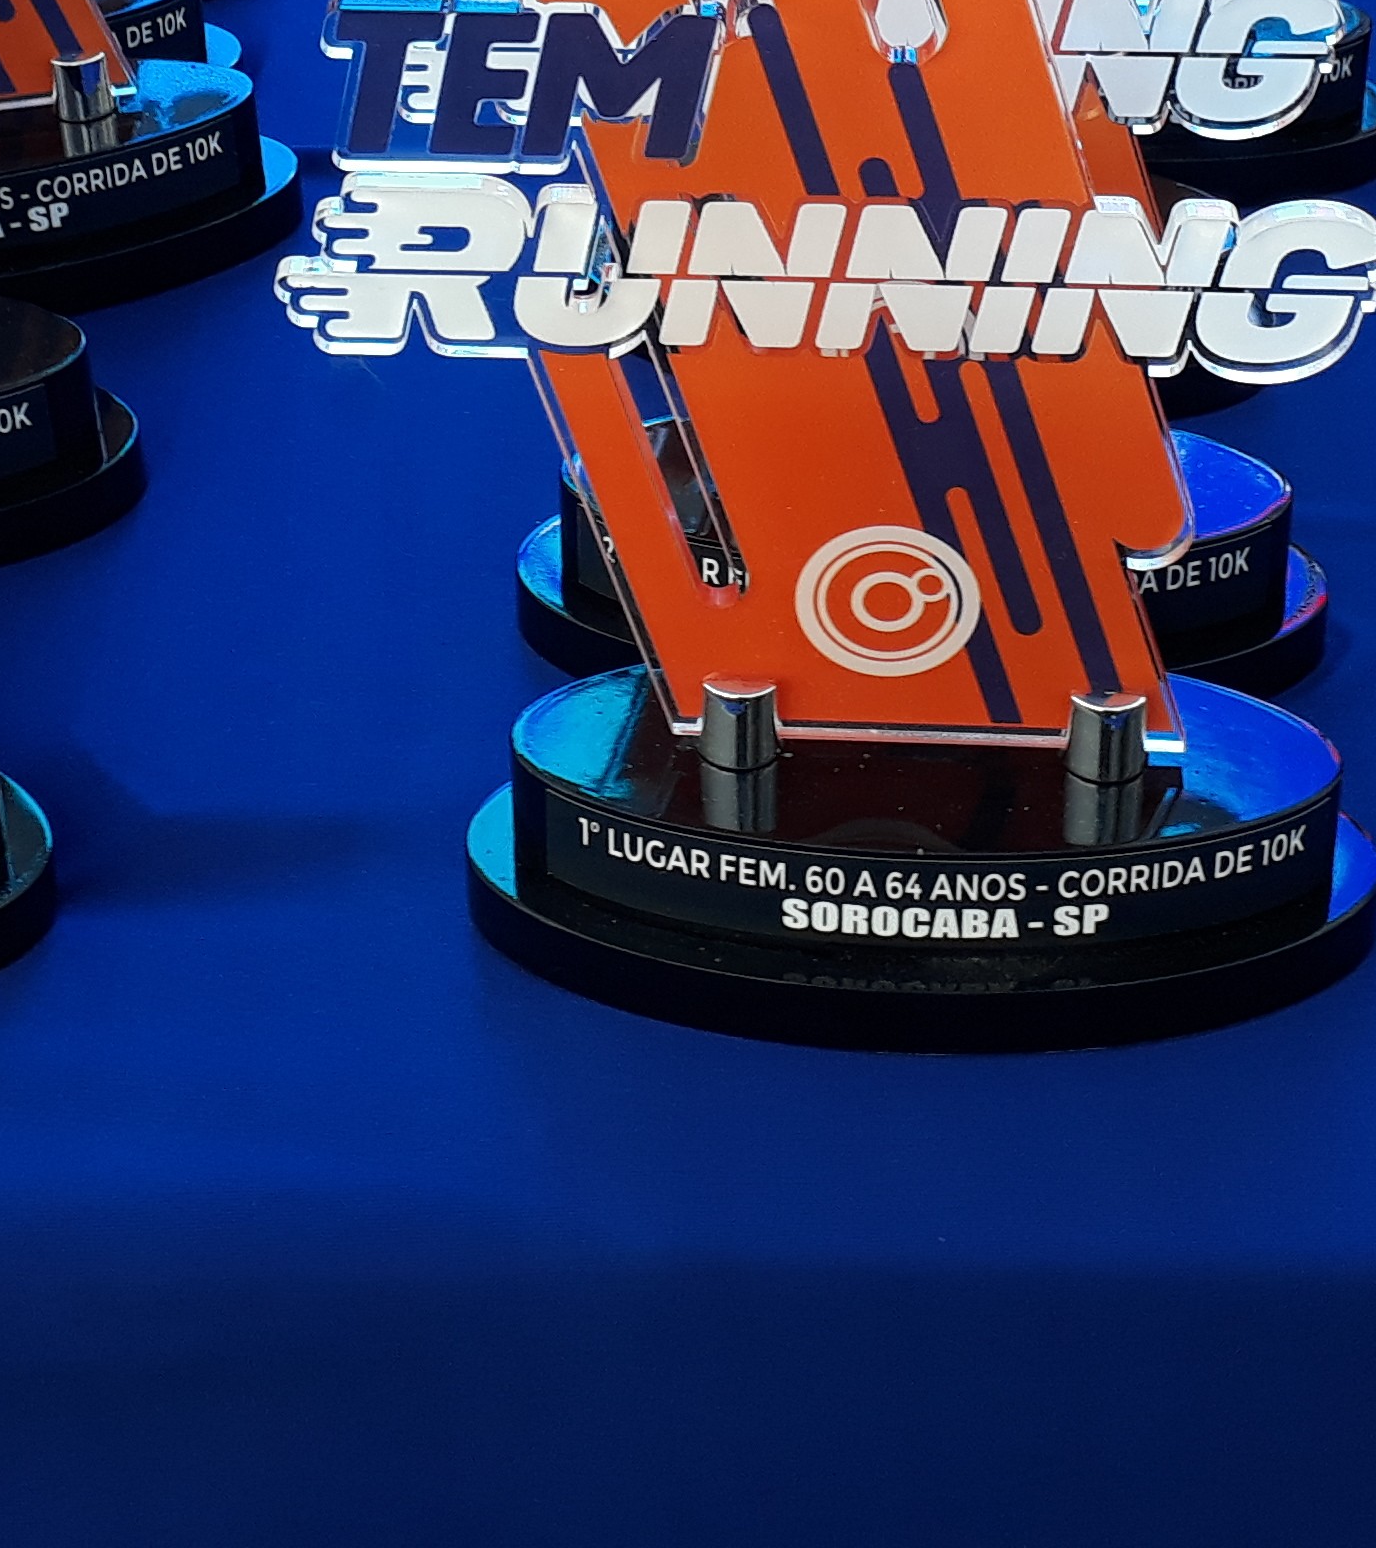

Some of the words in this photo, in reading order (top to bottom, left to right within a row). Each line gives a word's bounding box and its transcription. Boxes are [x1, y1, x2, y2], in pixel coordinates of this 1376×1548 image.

[126, 21, 154, 49] DE
[157, 6, 187, 38] 10K
[330, 5, 728, 164] TEM
[35, 158, 149, 203] CORRIDA
[151, 145, 184, 177] DE
[187, 131, 225, 166] 10K
[27, 202, 71, 232] SP
[1166, 560, 1202, 592] DE
[1208, 546, 1252, 583] 10K
[607, 828, 711, 879] LUGAR
[720, 854, 796, 891] FEM.
[805, 865, 845, 896] 60
[853, 870, 878, 898] A
[885, 872, 922, 901] 64
[929, 872, 1027, 902] ANOS
[1058, 857, 1207, 899] CORRIDA
[1213, 845, 1255, 879] DE
[1259, 824, 1307, 866] 10K
[781, 898, 1020, 939] SOROCABA
[1053, 903, 1111, 936] SP
